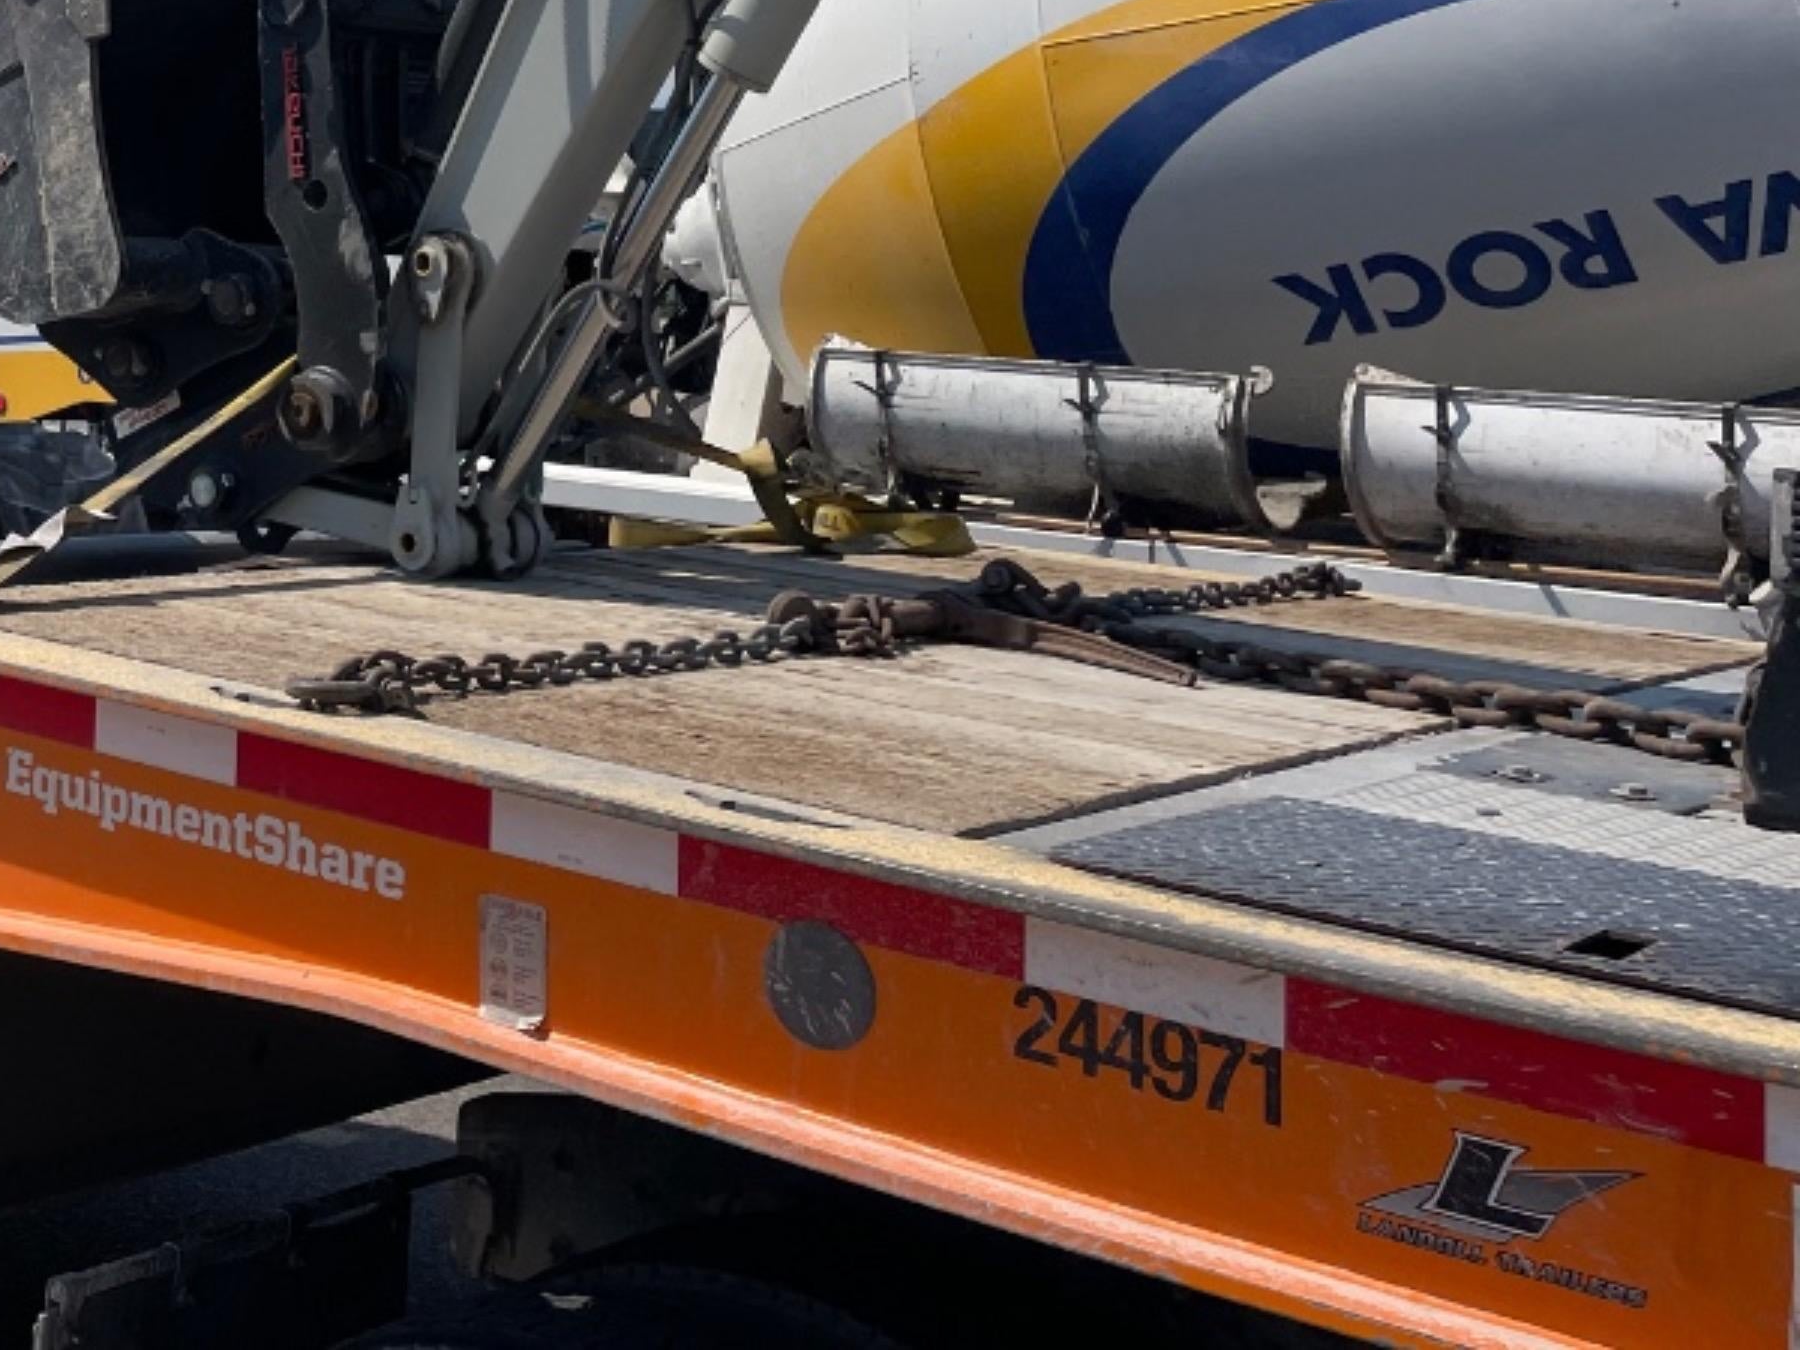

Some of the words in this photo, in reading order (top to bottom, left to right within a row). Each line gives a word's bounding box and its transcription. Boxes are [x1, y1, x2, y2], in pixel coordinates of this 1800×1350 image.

[1270, 209, 1639, 345] ROCK
[5, 747, 407, 901] EquipmentShare
[1013, 984, 1282, 1127] 244971
[1356, 1211, 1489, 1266] LANDOLL
